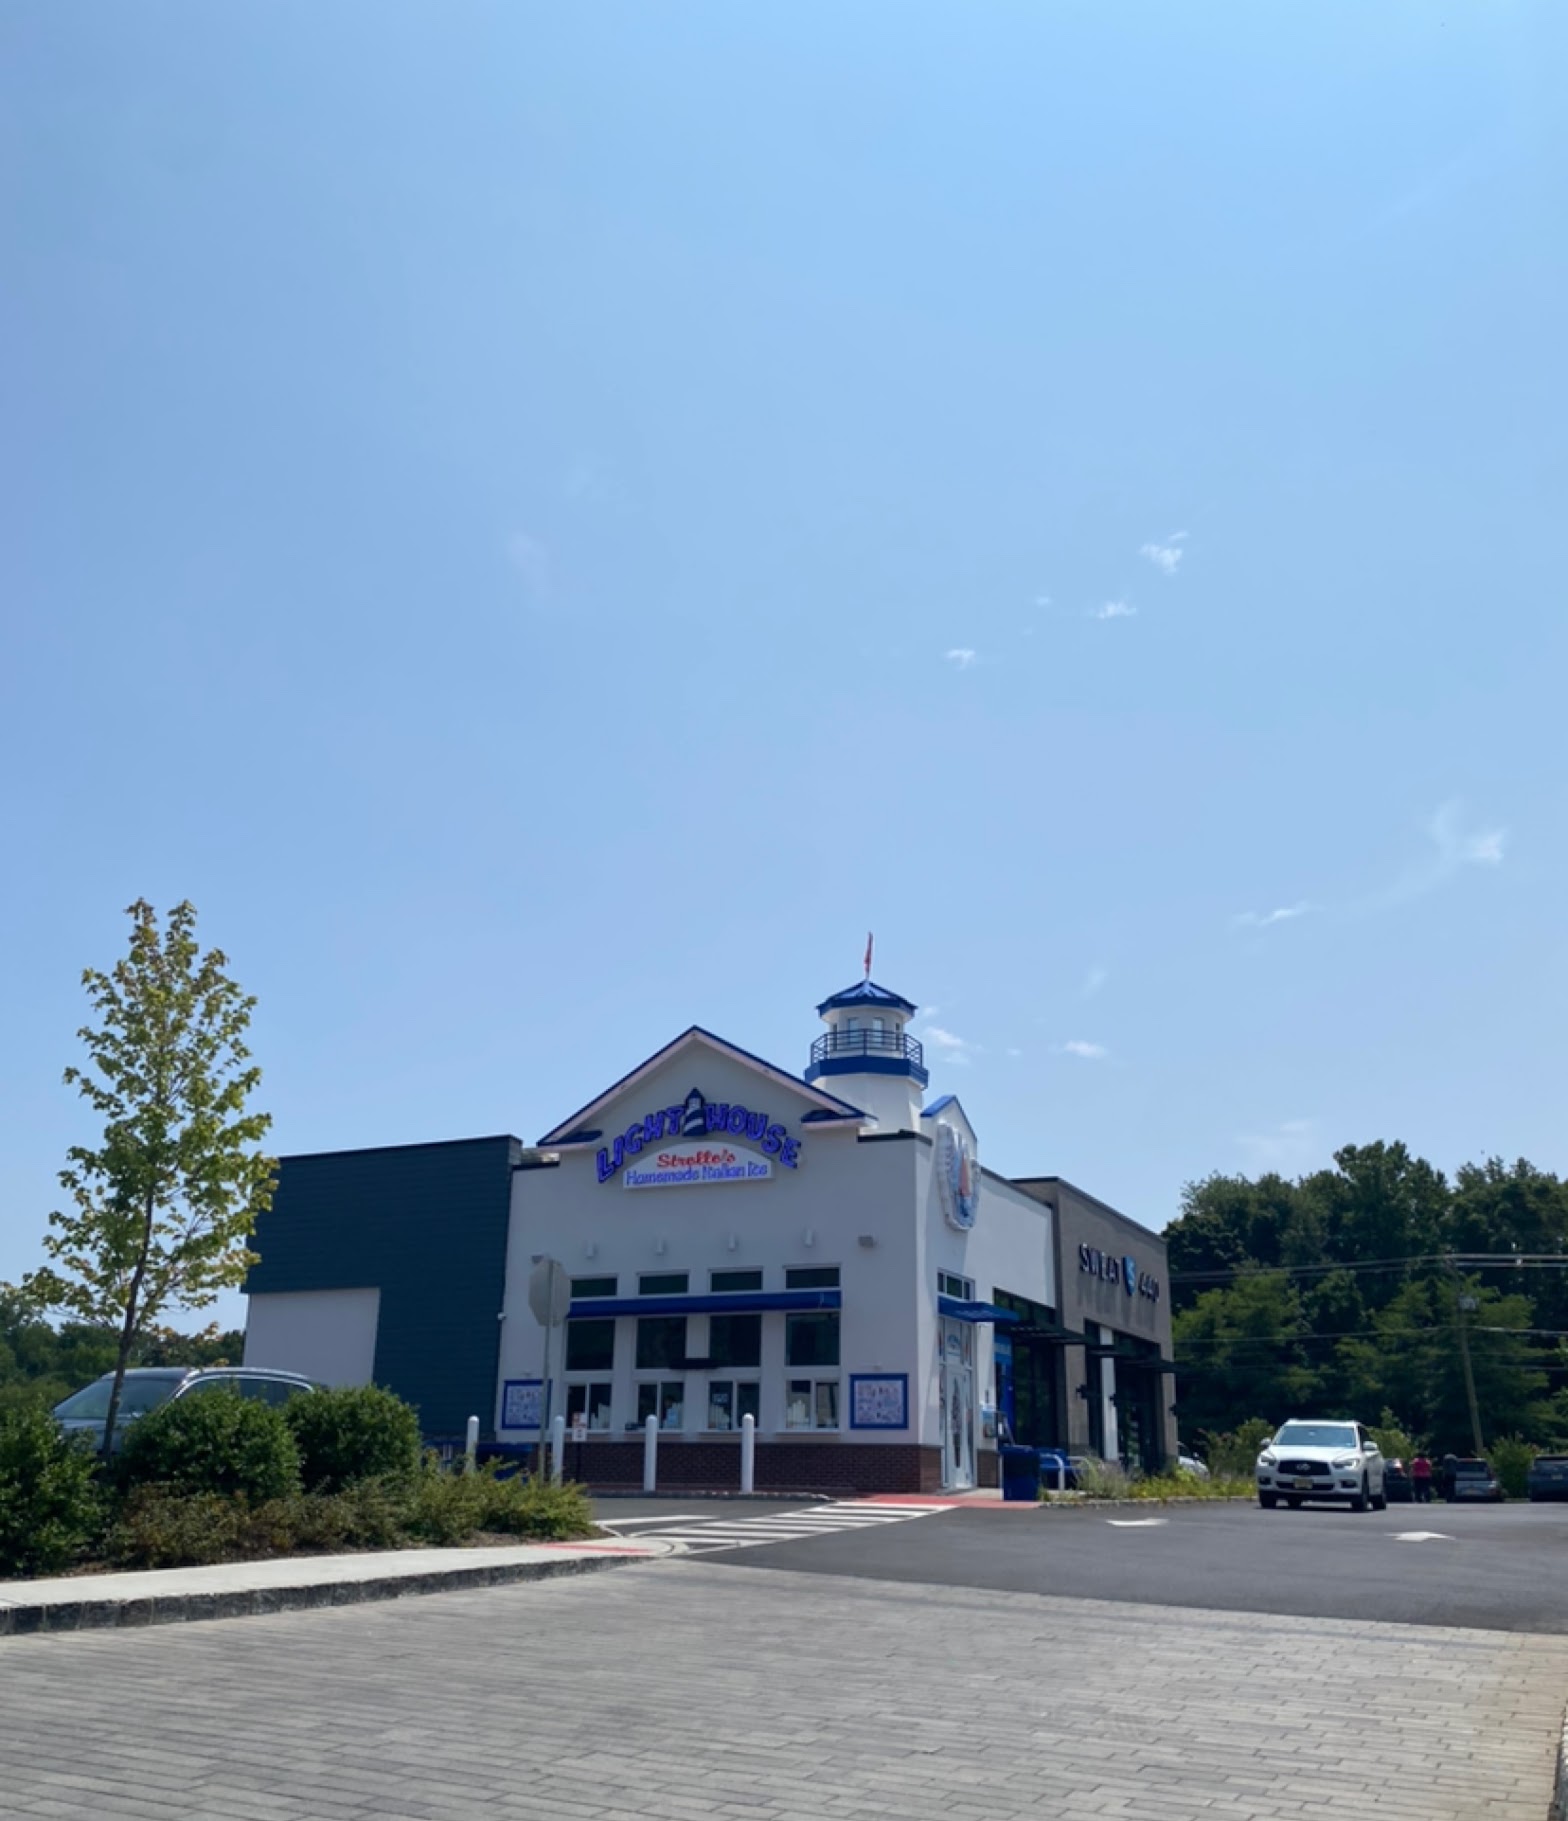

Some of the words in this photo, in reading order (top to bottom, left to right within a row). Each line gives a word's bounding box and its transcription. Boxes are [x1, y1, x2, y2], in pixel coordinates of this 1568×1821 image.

[596, 1105, 685, 1183] LIGHT
[704, 1103, 801, 1169] HOUSE
[626, 1167, 699, 1185] Homemade
[702, 1163, 745, 1179] Italian
[747, 1160, 768, 1177] Ice
